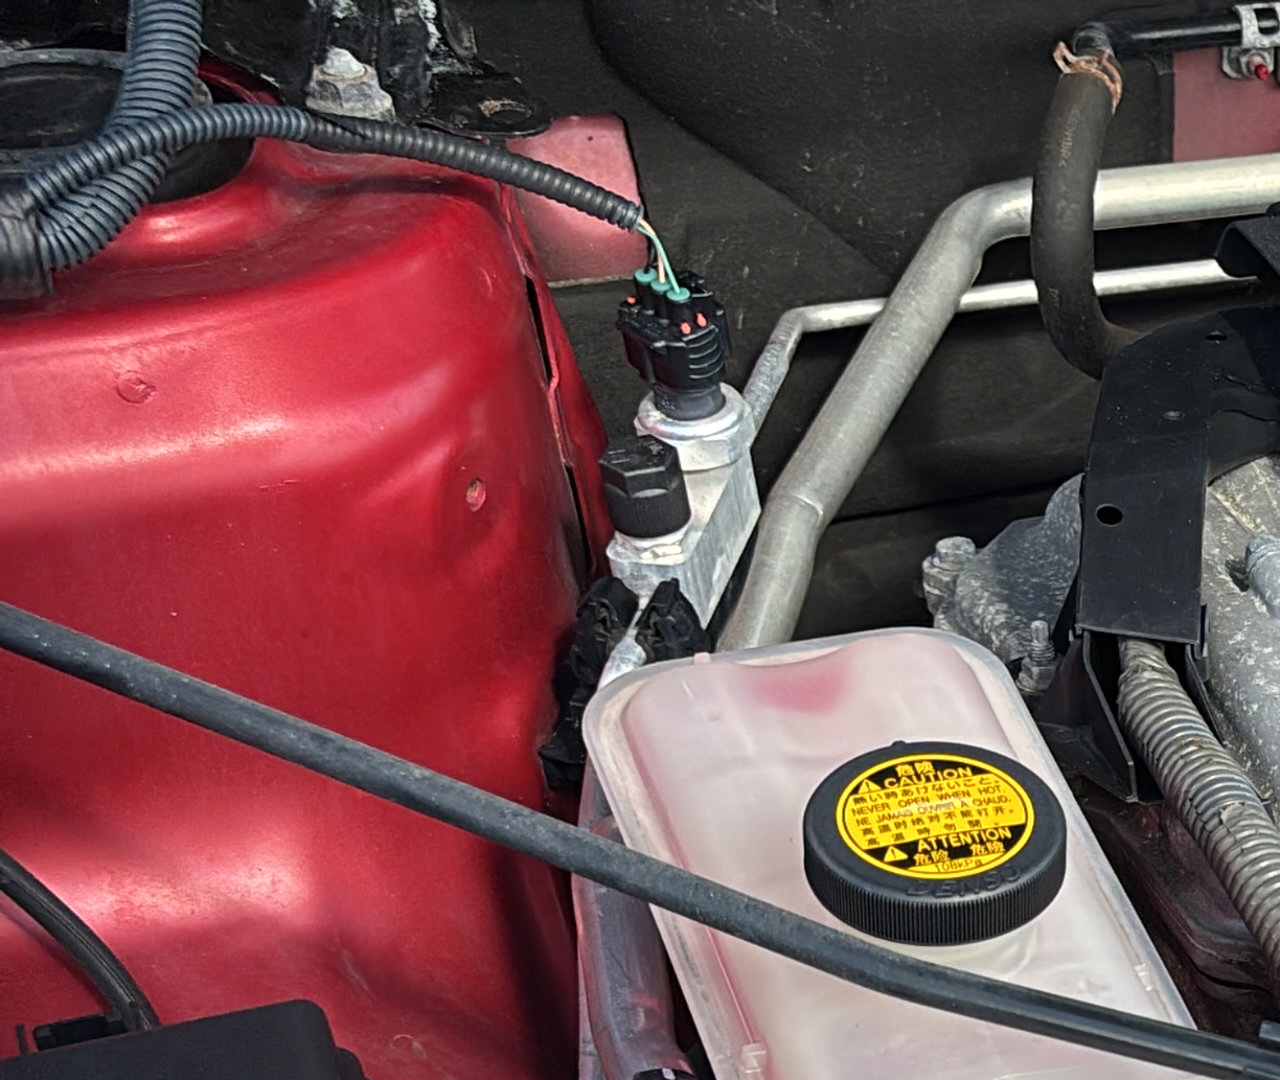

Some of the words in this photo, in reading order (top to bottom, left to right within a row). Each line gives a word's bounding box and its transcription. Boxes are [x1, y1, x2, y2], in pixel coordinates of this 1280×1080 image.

[884, 767, 974, 788] CAUTION
[851, 802, 891, 817] NEVER
[898, 795, 931, 808] OPEN
[936, 789, 972, 801] WHEN
[978, 785, 1006, 796] HOT.
[855, 816, 871, 827] NE
[876, 808, 914, 824] JAMAIS
[917, 801, 955, 815] OUVRIR
[972, 795, 1012, 808] CHAUD.
[917, 826, 1012, 853] ATTENTION
[934, 858, 983, 873] 108kPa
[905, 863, 1021, 899] DENSO
